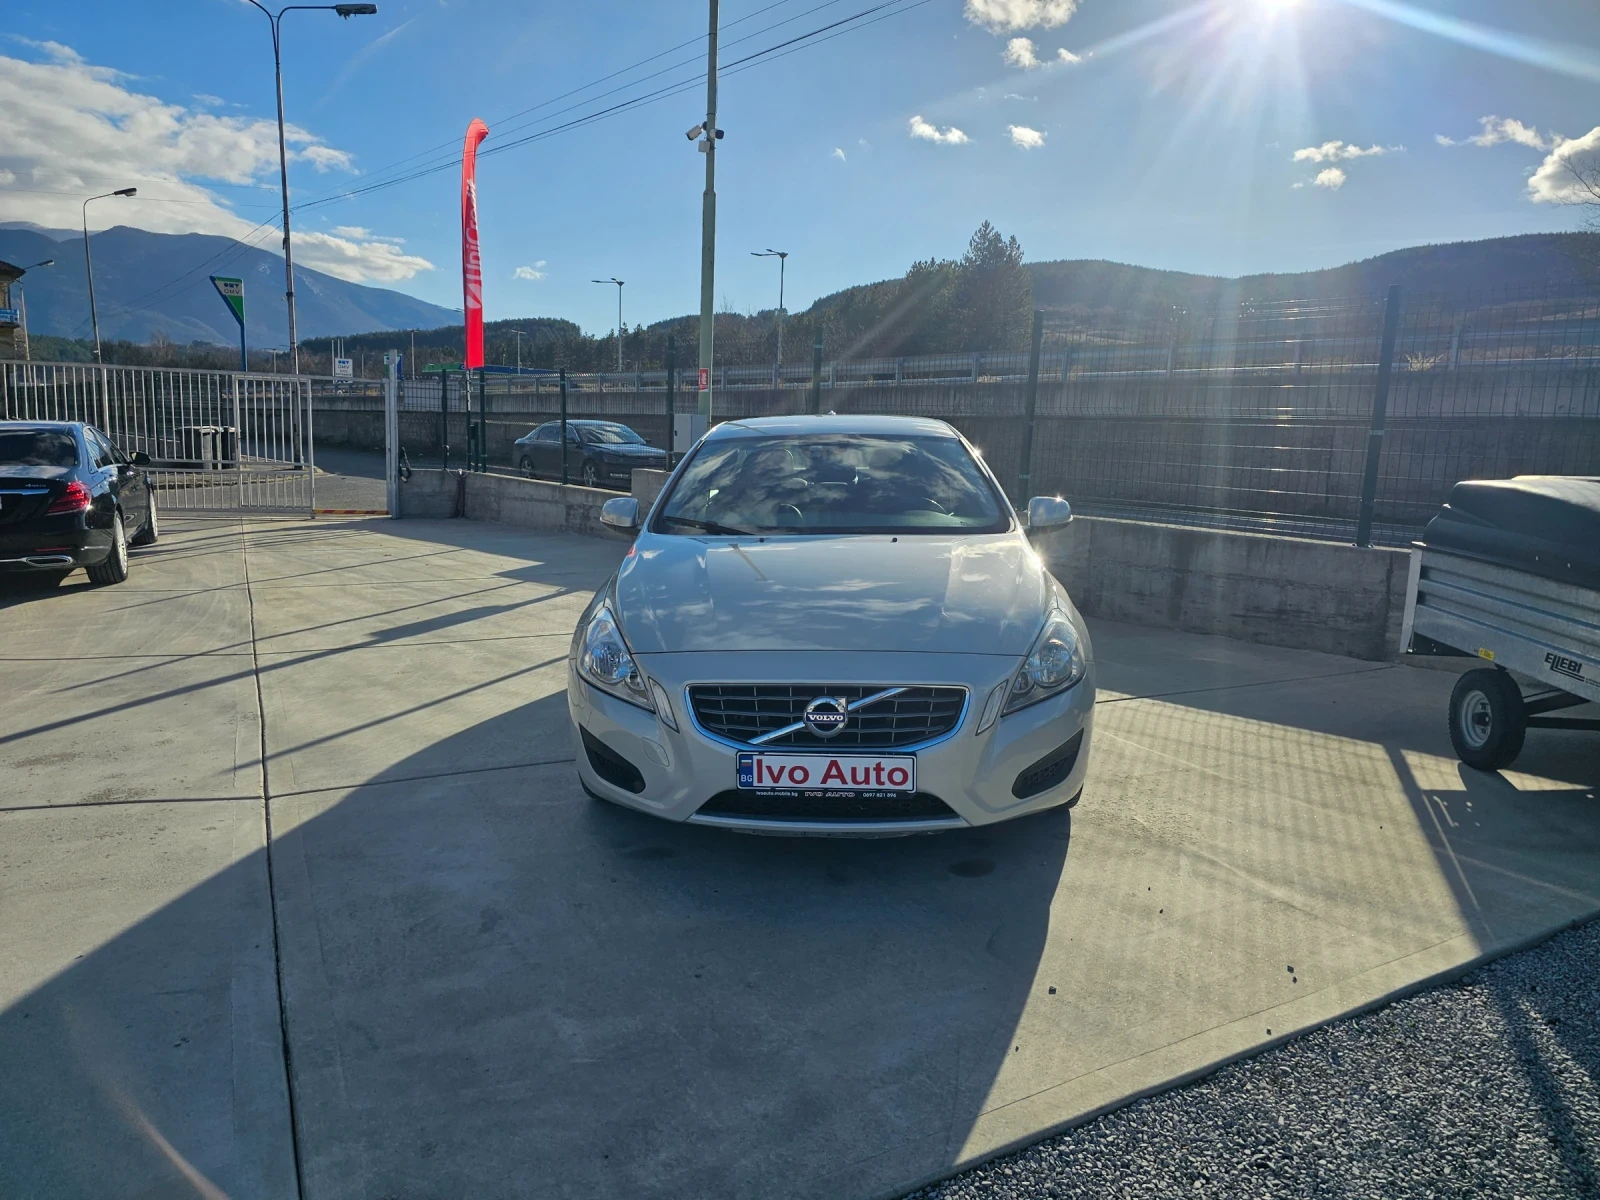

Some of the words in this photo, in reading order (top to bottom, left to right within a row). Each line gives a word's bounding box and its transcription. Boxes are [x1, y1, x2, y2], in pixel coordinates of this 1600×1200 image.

[1544, 651, 1583, 674] ELLEBI
[740, 774, 753, 782] BG
[756, 758, 810, 785] Ivo
[820, 759, 909, 787] Auto
